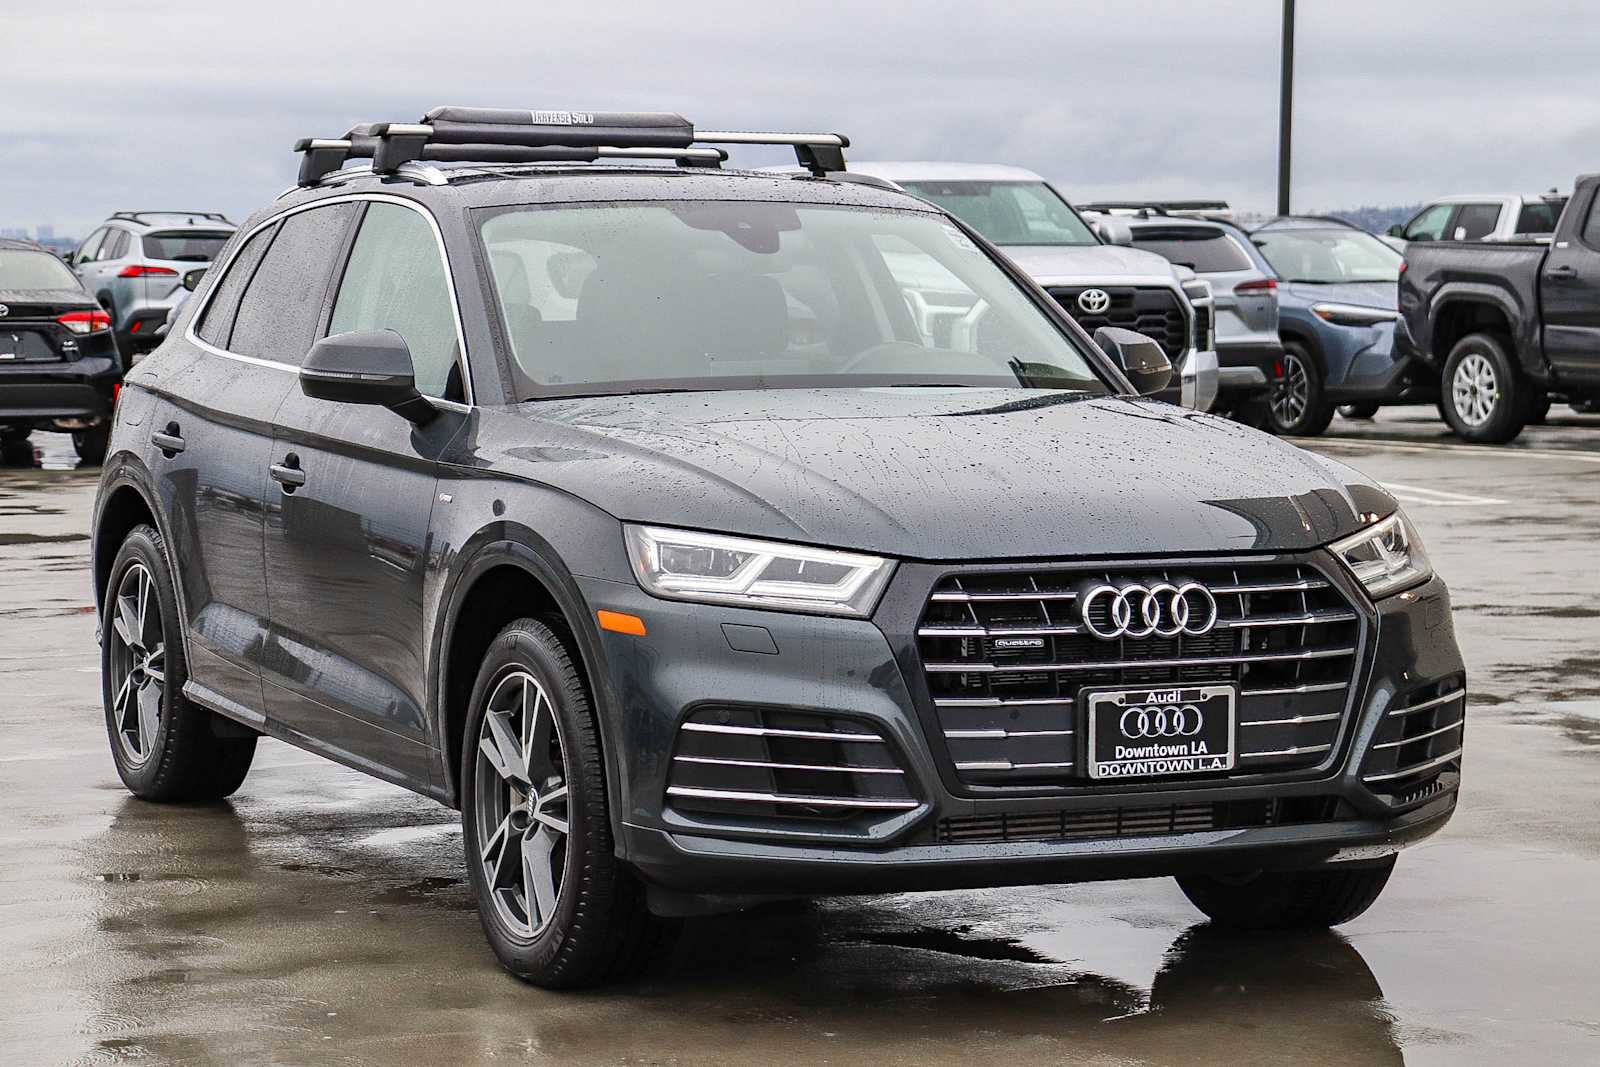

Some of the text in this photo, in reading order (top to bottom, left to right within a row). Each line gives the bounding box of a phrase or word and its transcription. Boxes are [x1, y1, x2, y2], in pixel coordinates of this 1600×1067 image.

[1145, 691, 1181, 704] Audi
[1115, 741, 1208, 759] Downtown LA
[1099, 757, 1226, 776] DOWNTOWN L.A.
